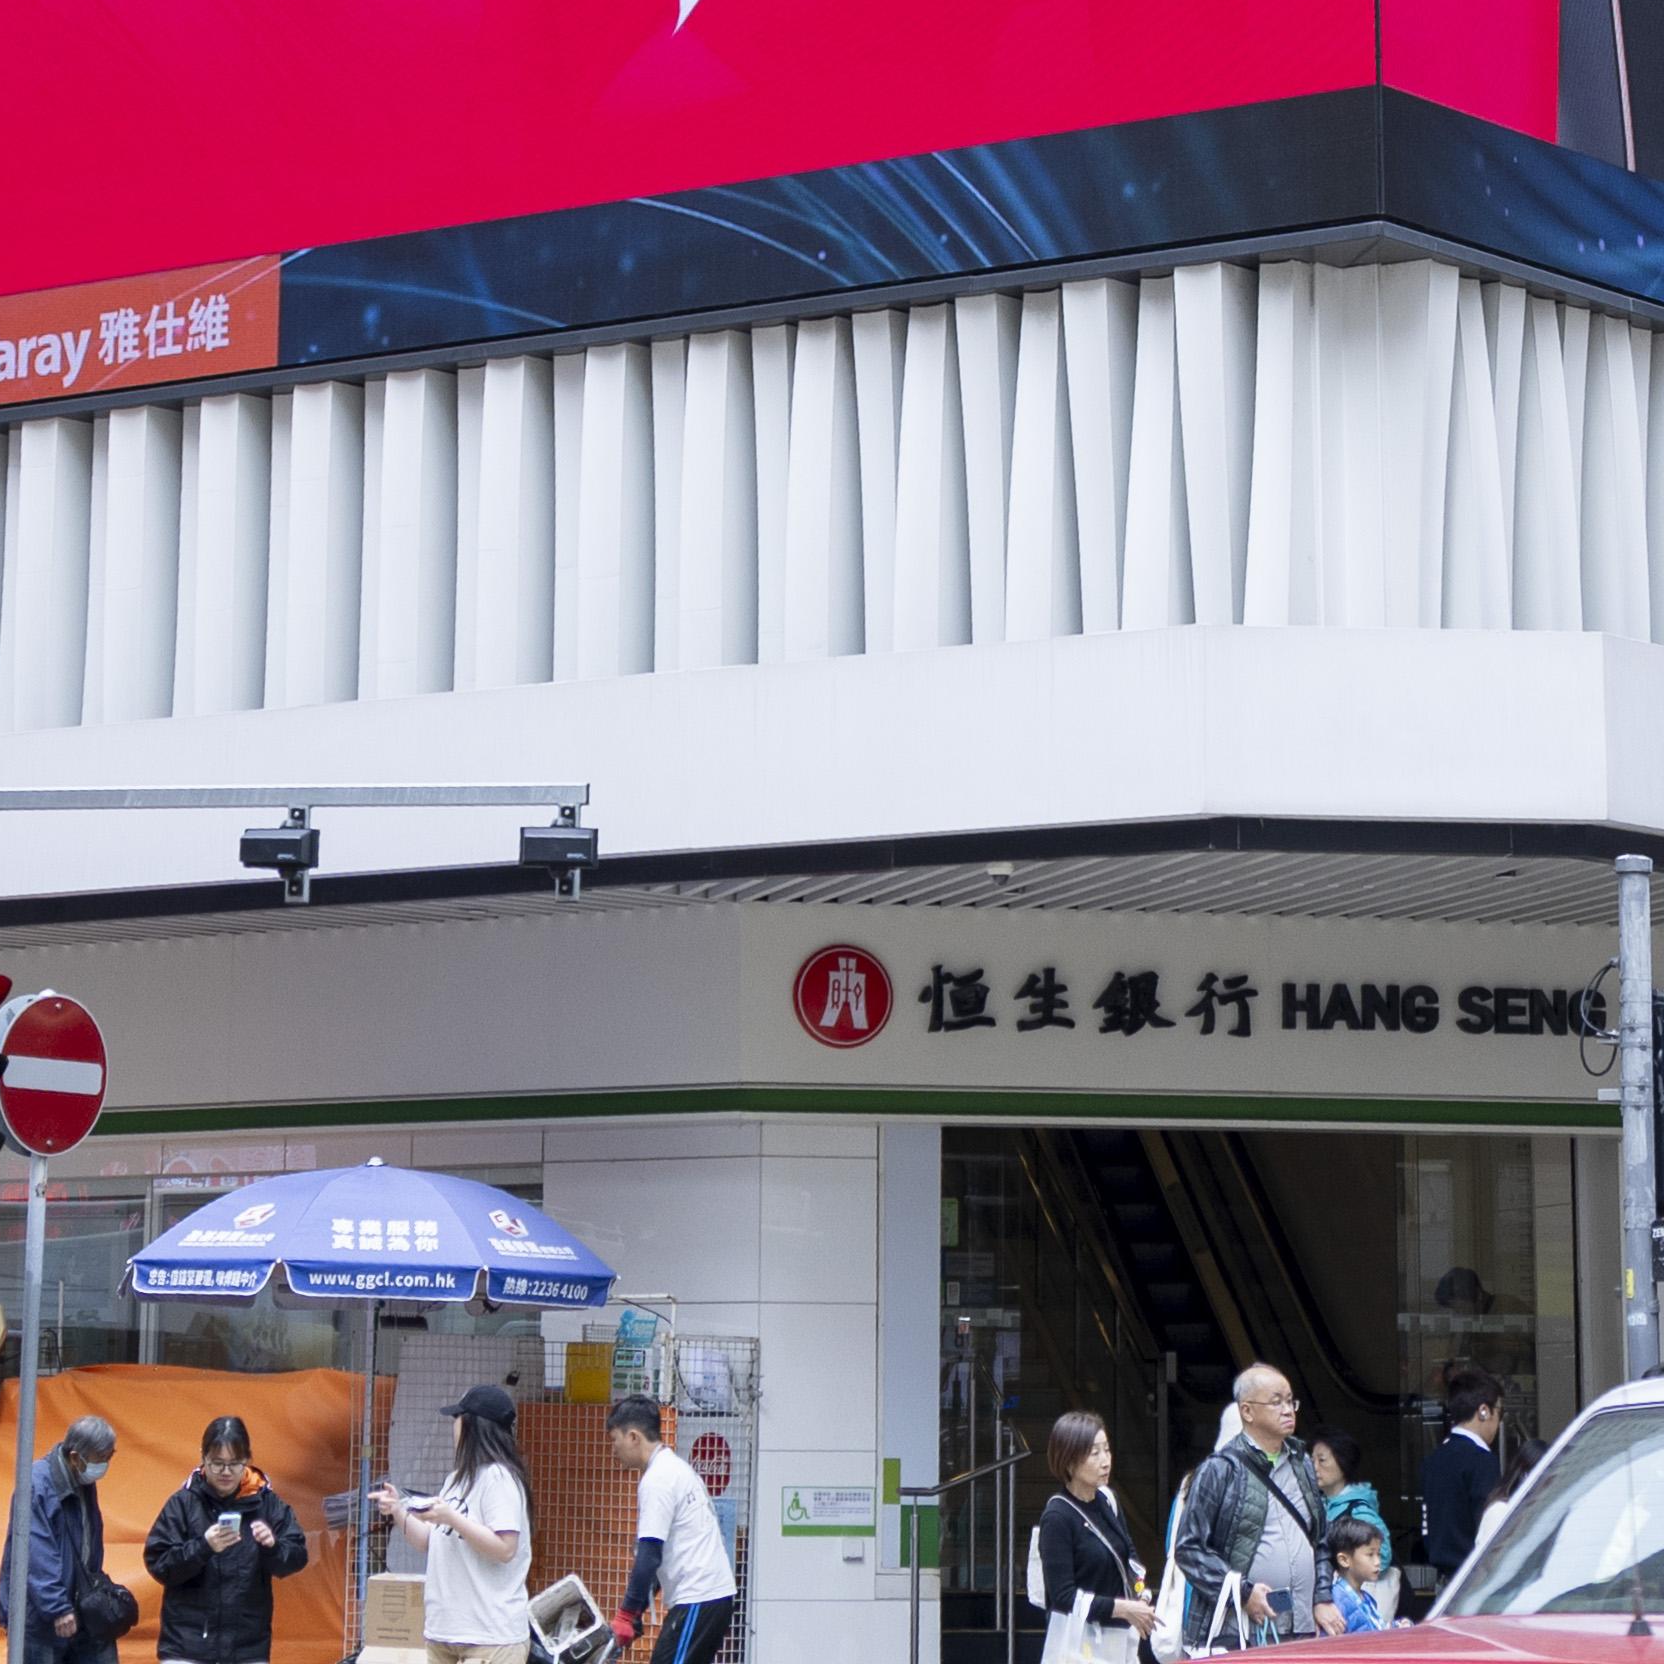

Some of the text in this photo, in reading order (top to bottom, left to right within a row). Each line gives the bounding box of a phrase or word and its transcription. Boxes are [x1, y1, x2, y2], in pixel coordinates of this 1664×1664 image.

[98, 293, 230, 366] 雅仕維
[918, 963, 1258, 1039] 恒生銀行
[1281, 979, 1439, 1033] HANG
[1456, 984, 1607, 1038] SENG
[309, 1270, 456, 1290] www.ggcl.com.hk
